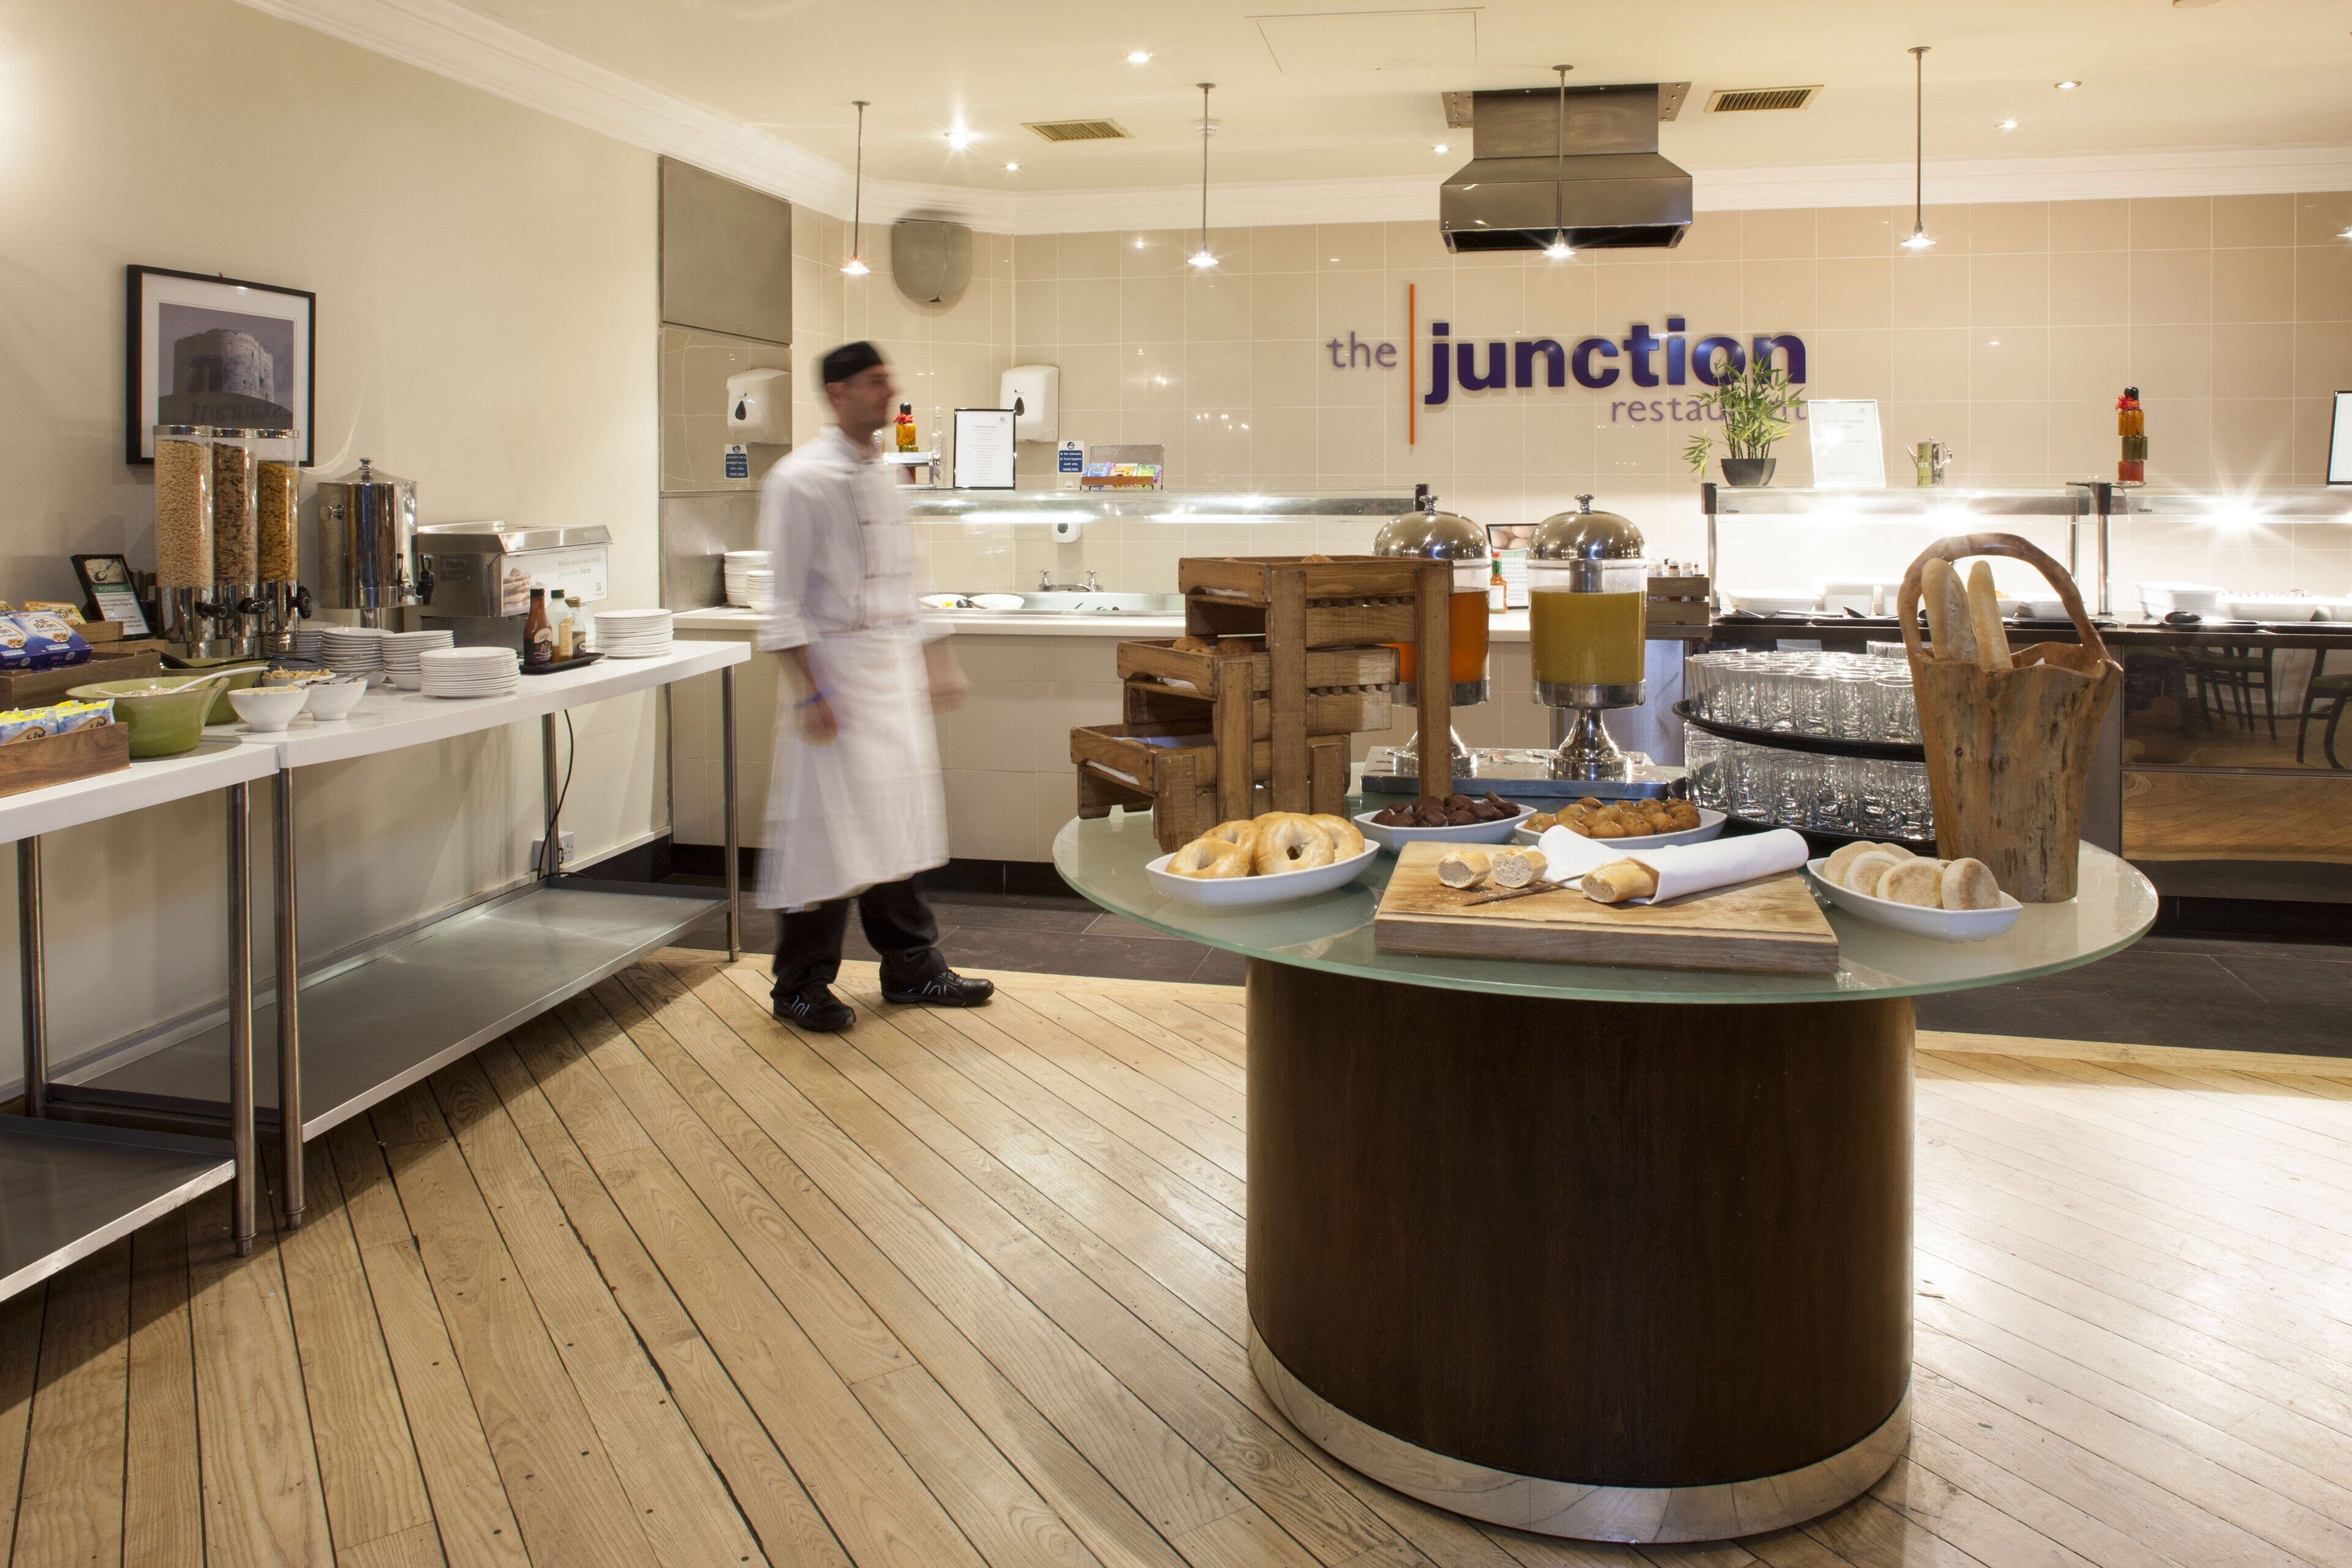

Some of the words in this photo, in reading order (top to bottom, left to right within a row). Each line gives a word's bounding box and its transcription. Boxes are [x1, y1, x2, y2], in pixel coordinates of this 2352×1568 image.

[1327, 331, 1397, 368] the
[1425, 318, 1806, 404] junction
[1093, 447, 1120, 456] Tetley
[570, 559, 581, 568] your
